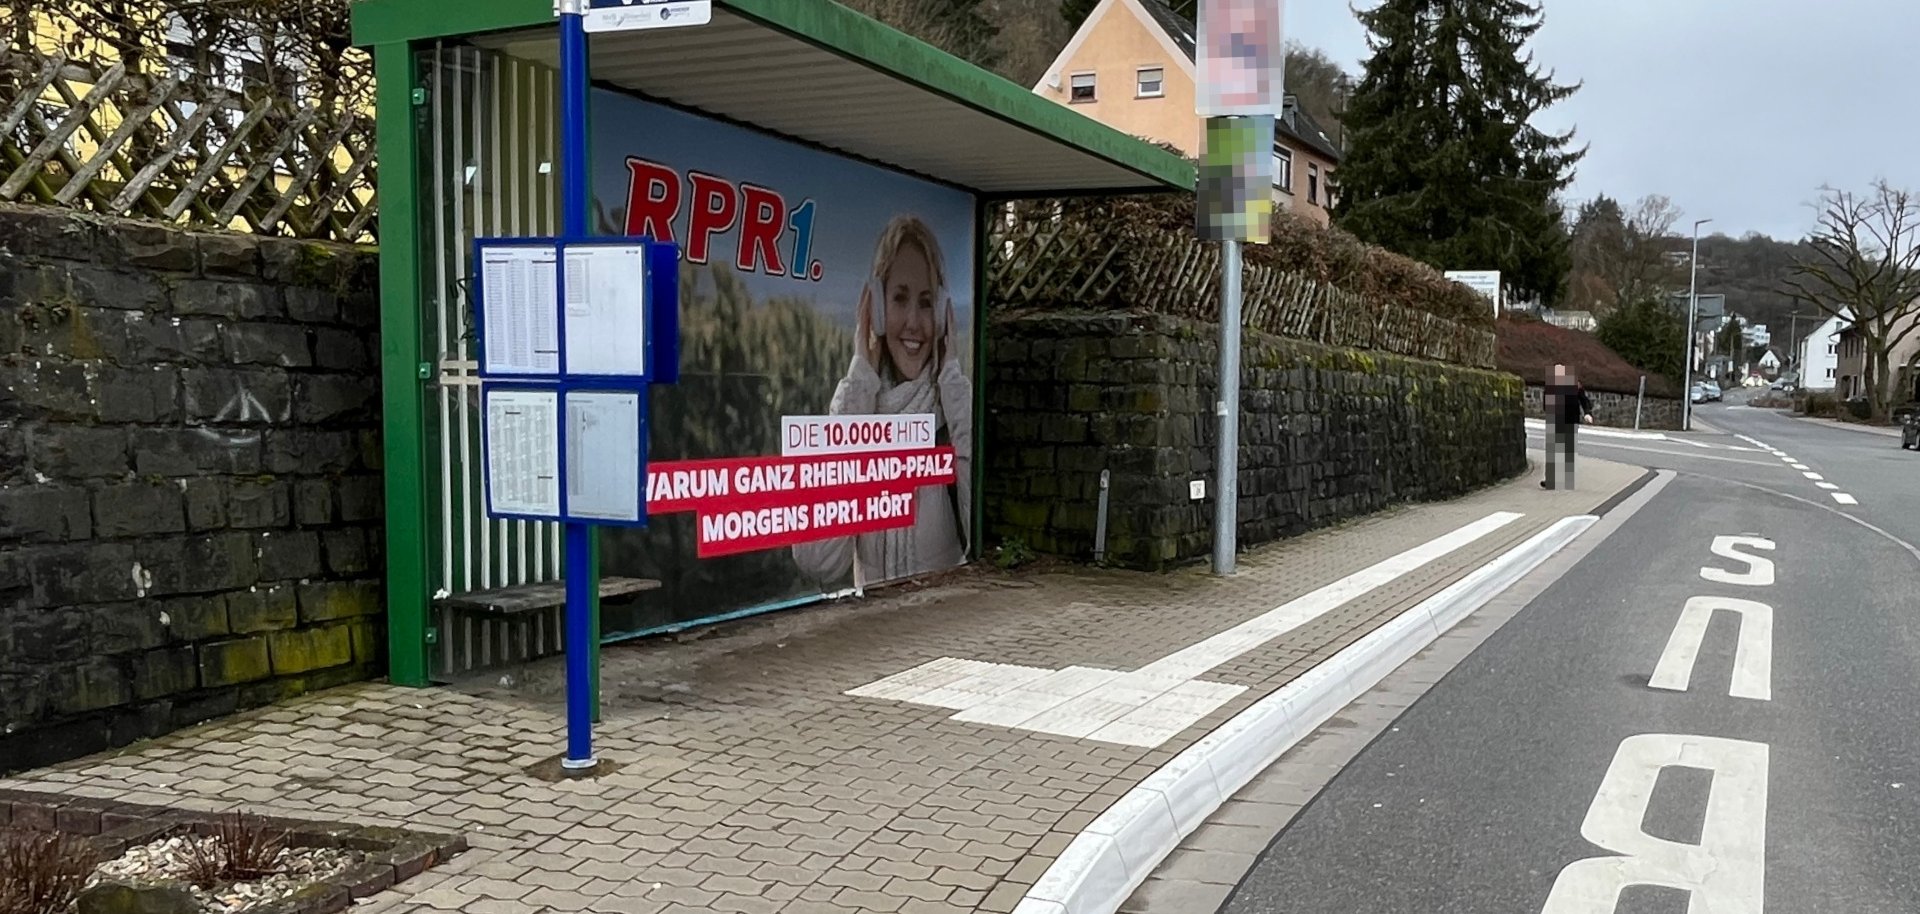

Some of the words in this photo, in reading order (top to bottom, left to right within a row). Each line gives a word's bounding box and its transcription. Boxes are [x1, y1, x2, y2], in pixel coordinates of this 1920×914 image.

[624, 155, 824, 282] RPR1.
[788, 422, 819, 449] DIE
[823, 421, 893, 447] 10.000€
[896, 420, 931, 444] HITS
[734, 463, 796, 495] GANZ
[801, 454, 953, 488] RHEINLAND-PFALZ
[702, 504, 809, 544] MORGENS
[813, 499, 863, 529] RPR1.
[866, 490, 913, 521] HÖRT
